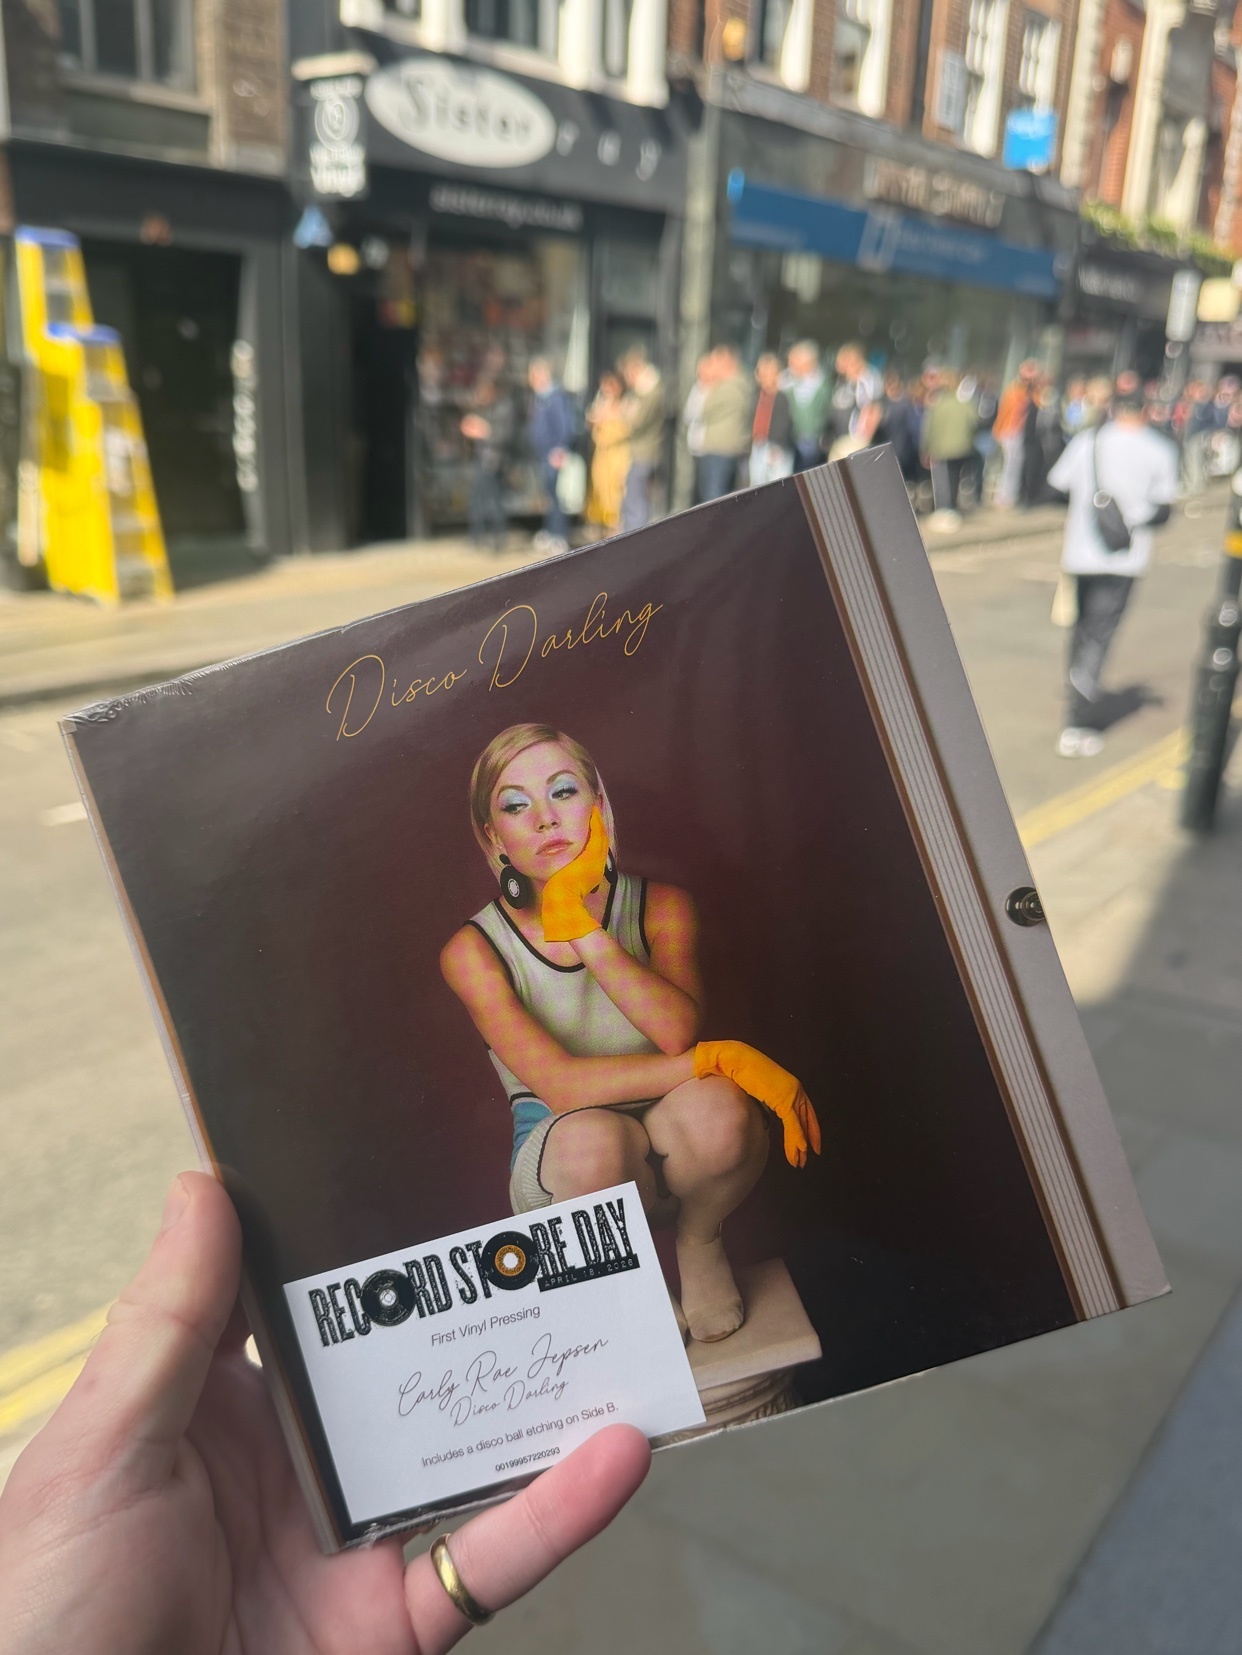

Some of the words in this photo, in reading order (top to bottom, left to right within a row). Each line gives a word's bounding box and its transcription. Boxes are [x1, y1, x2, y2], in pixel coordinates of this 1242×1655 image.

[325, 653, 467, 742] Disco
[478, 591, 664, 692] Darling
[308, 1254, 453, 1347] RECORD
[449, 1216, 575, 1304] STORE
[571, 1198, 635, 1265] DAY
[544, 1273, 578, 1288] APRIL
[606, 1257, 635, 1273] 2026
[431, 1329, 457, 1347] First
[459, 1319, 487, 1336] Vinyl
[490, 1306, 541, 1329] Pressing
[398, 1369, 461, 1417] Carly
[465, 1350, 518, 1397] Rae
[527, 1332, 609, 1377] Jepsen
[450, 1395, 501, 1428] Disco
[503, 1376, 570, 1412] Darling
[422, 1448, 466, 1468] Includes
[466, 1445, 475, 1455] a
[475, 1436, 504, 1453] disco
[506, 1428, 524, 1444] ball
[526, 1418, 565, 1438] etching
[565, 1414, 580, 1425] on
[581, 1406, 606, 1421] Side
[606, 1402, 619, 1413] B.
